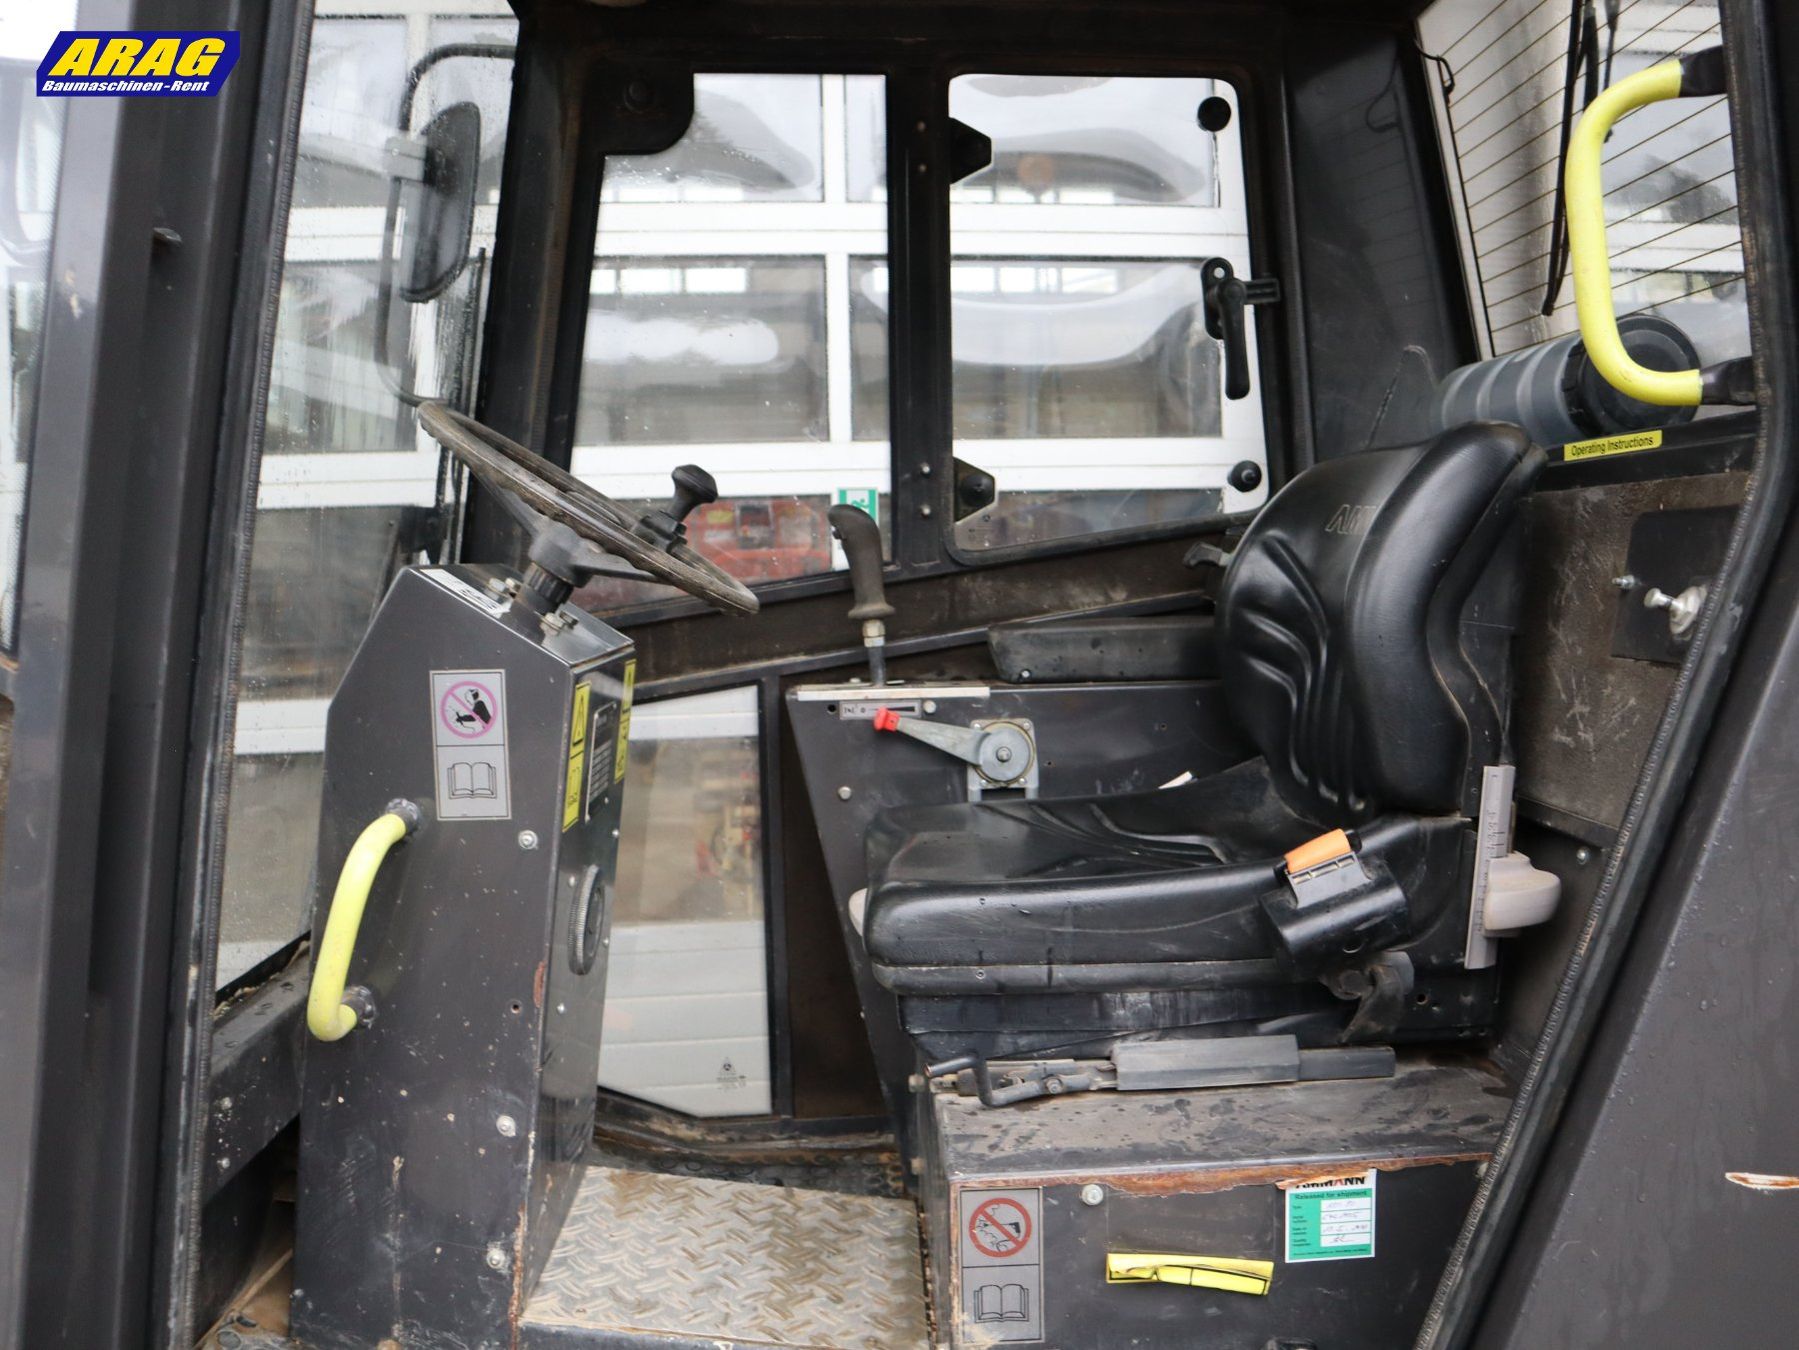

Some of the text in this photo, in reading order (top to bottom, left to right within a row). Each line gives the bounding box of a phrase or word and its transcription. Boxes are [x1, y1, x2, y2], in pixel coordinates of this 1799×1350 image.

[1571, 437, 1654, 456] Operating Instructions
[1337, 1190, 1367, 1198] shipment
